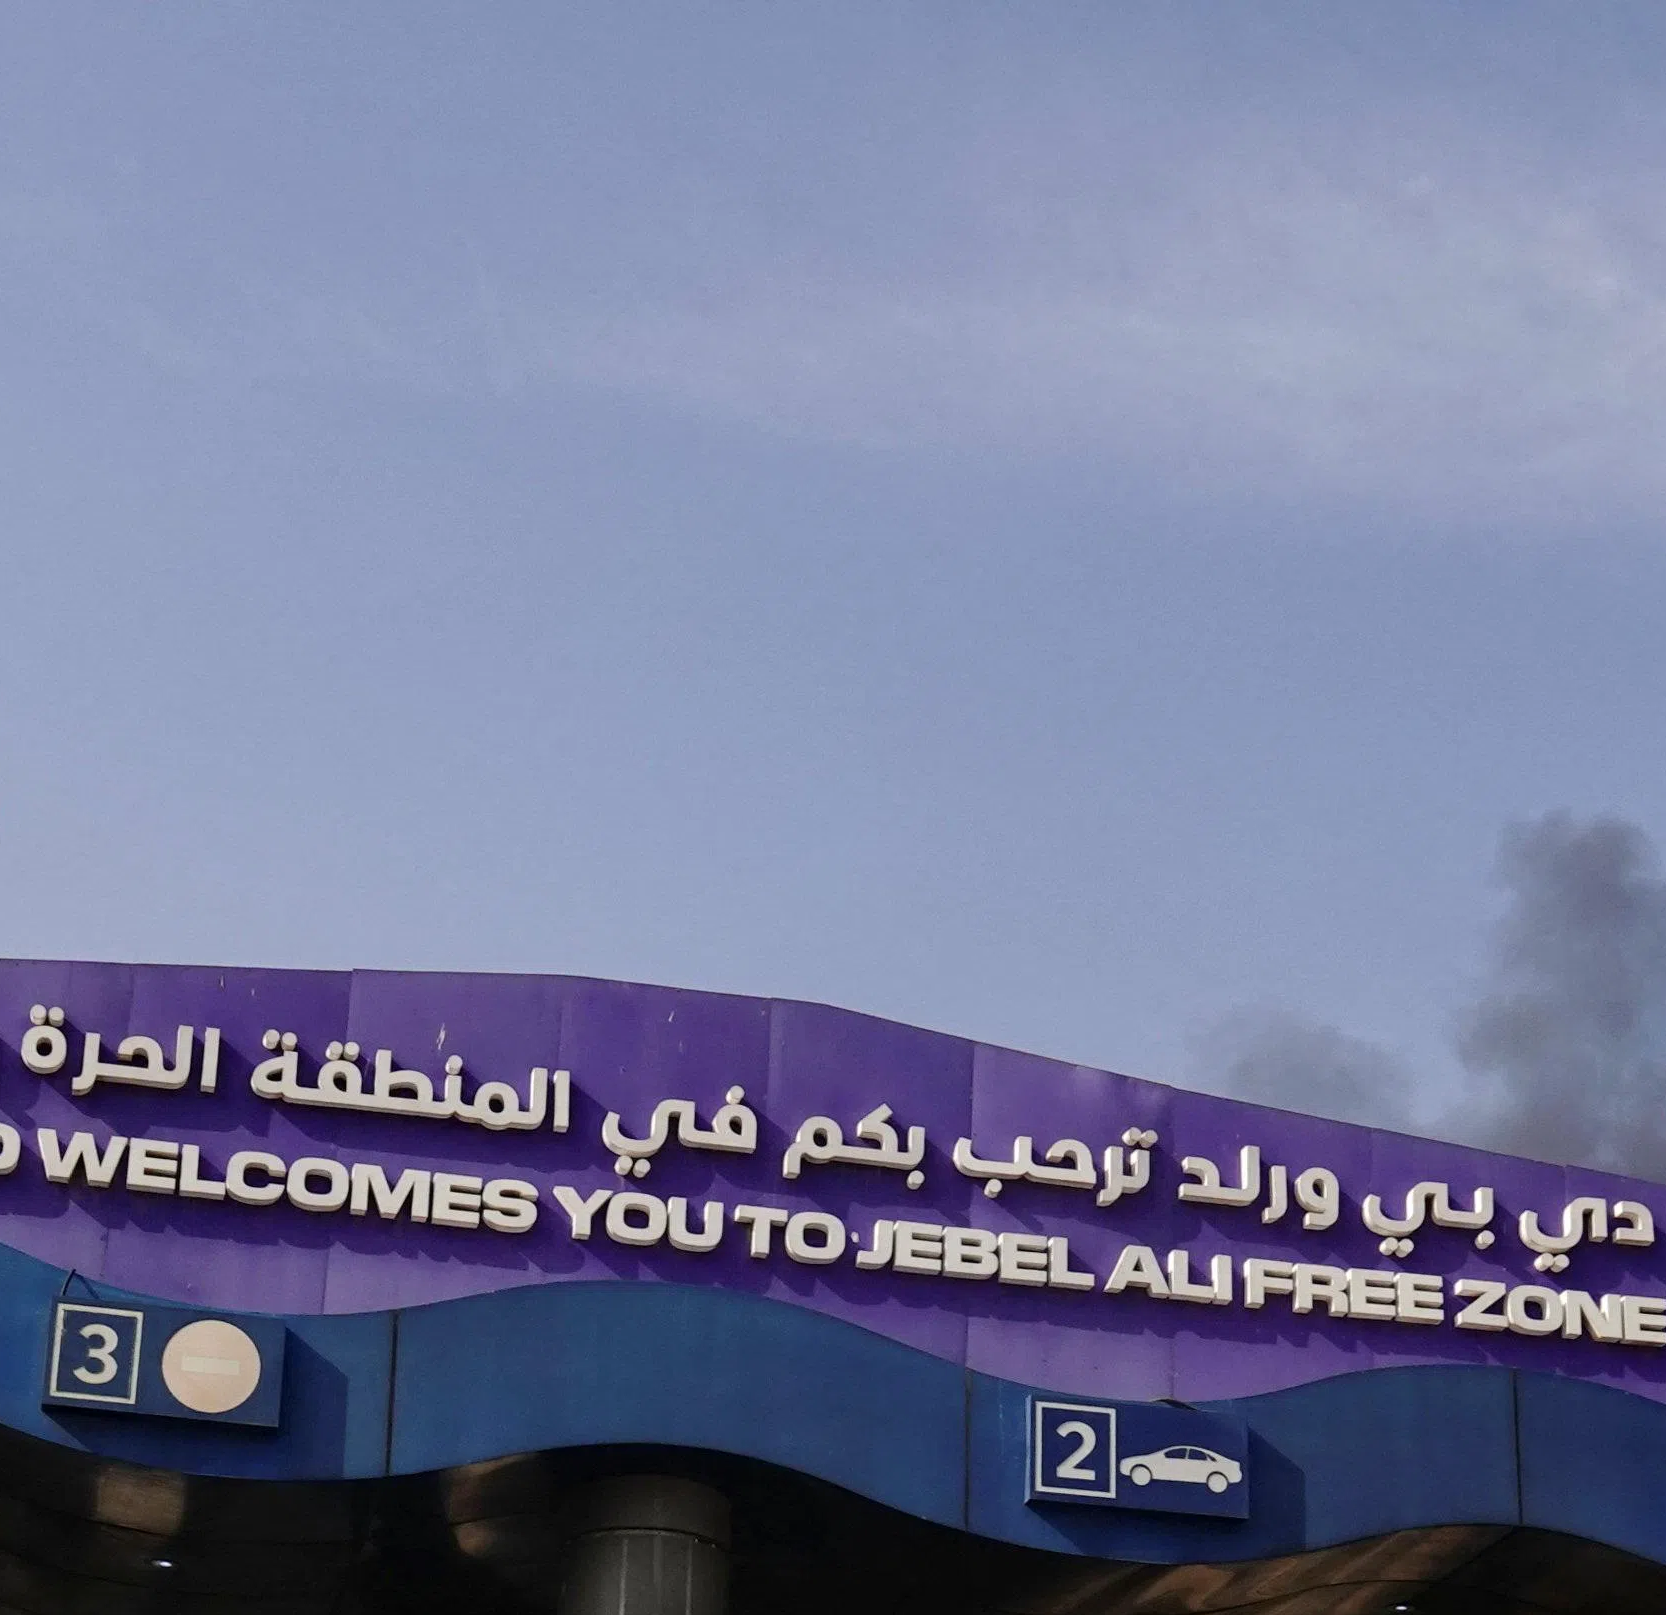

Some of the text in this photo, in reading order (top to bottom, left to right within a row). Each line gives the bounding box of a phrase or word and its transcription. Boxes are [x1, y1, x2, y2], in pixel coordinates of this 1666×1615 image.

[21, 1004, 220, 1096] الحرة
[251, 1029, 571, 1132] المنطقة
[602, 1086, 757, 1177] في
[783, 1104, 925, 1190] بكم
[953, 1127, 1158, 1206] ترحب
[37, 1128, 538, 1232] WELCOMES
[552, 1186, 724, 1252] YOU
[734, 1205, 845, 1264] TO
[856, 1220, 1095, 1291] JEBEL
[1104, 1245, 1232, 1305] ALI
[1243, 1258, 1444, 1325] FREE
[1178, 1146, 1339, 1230] ورلد
[1363, 1182, 1494, 1256] بي
[1519, 1197, 1655, 1273] دي
[73, 1323, 119, 1385] 3
[1055, 1421, 1097, 1482] 2
